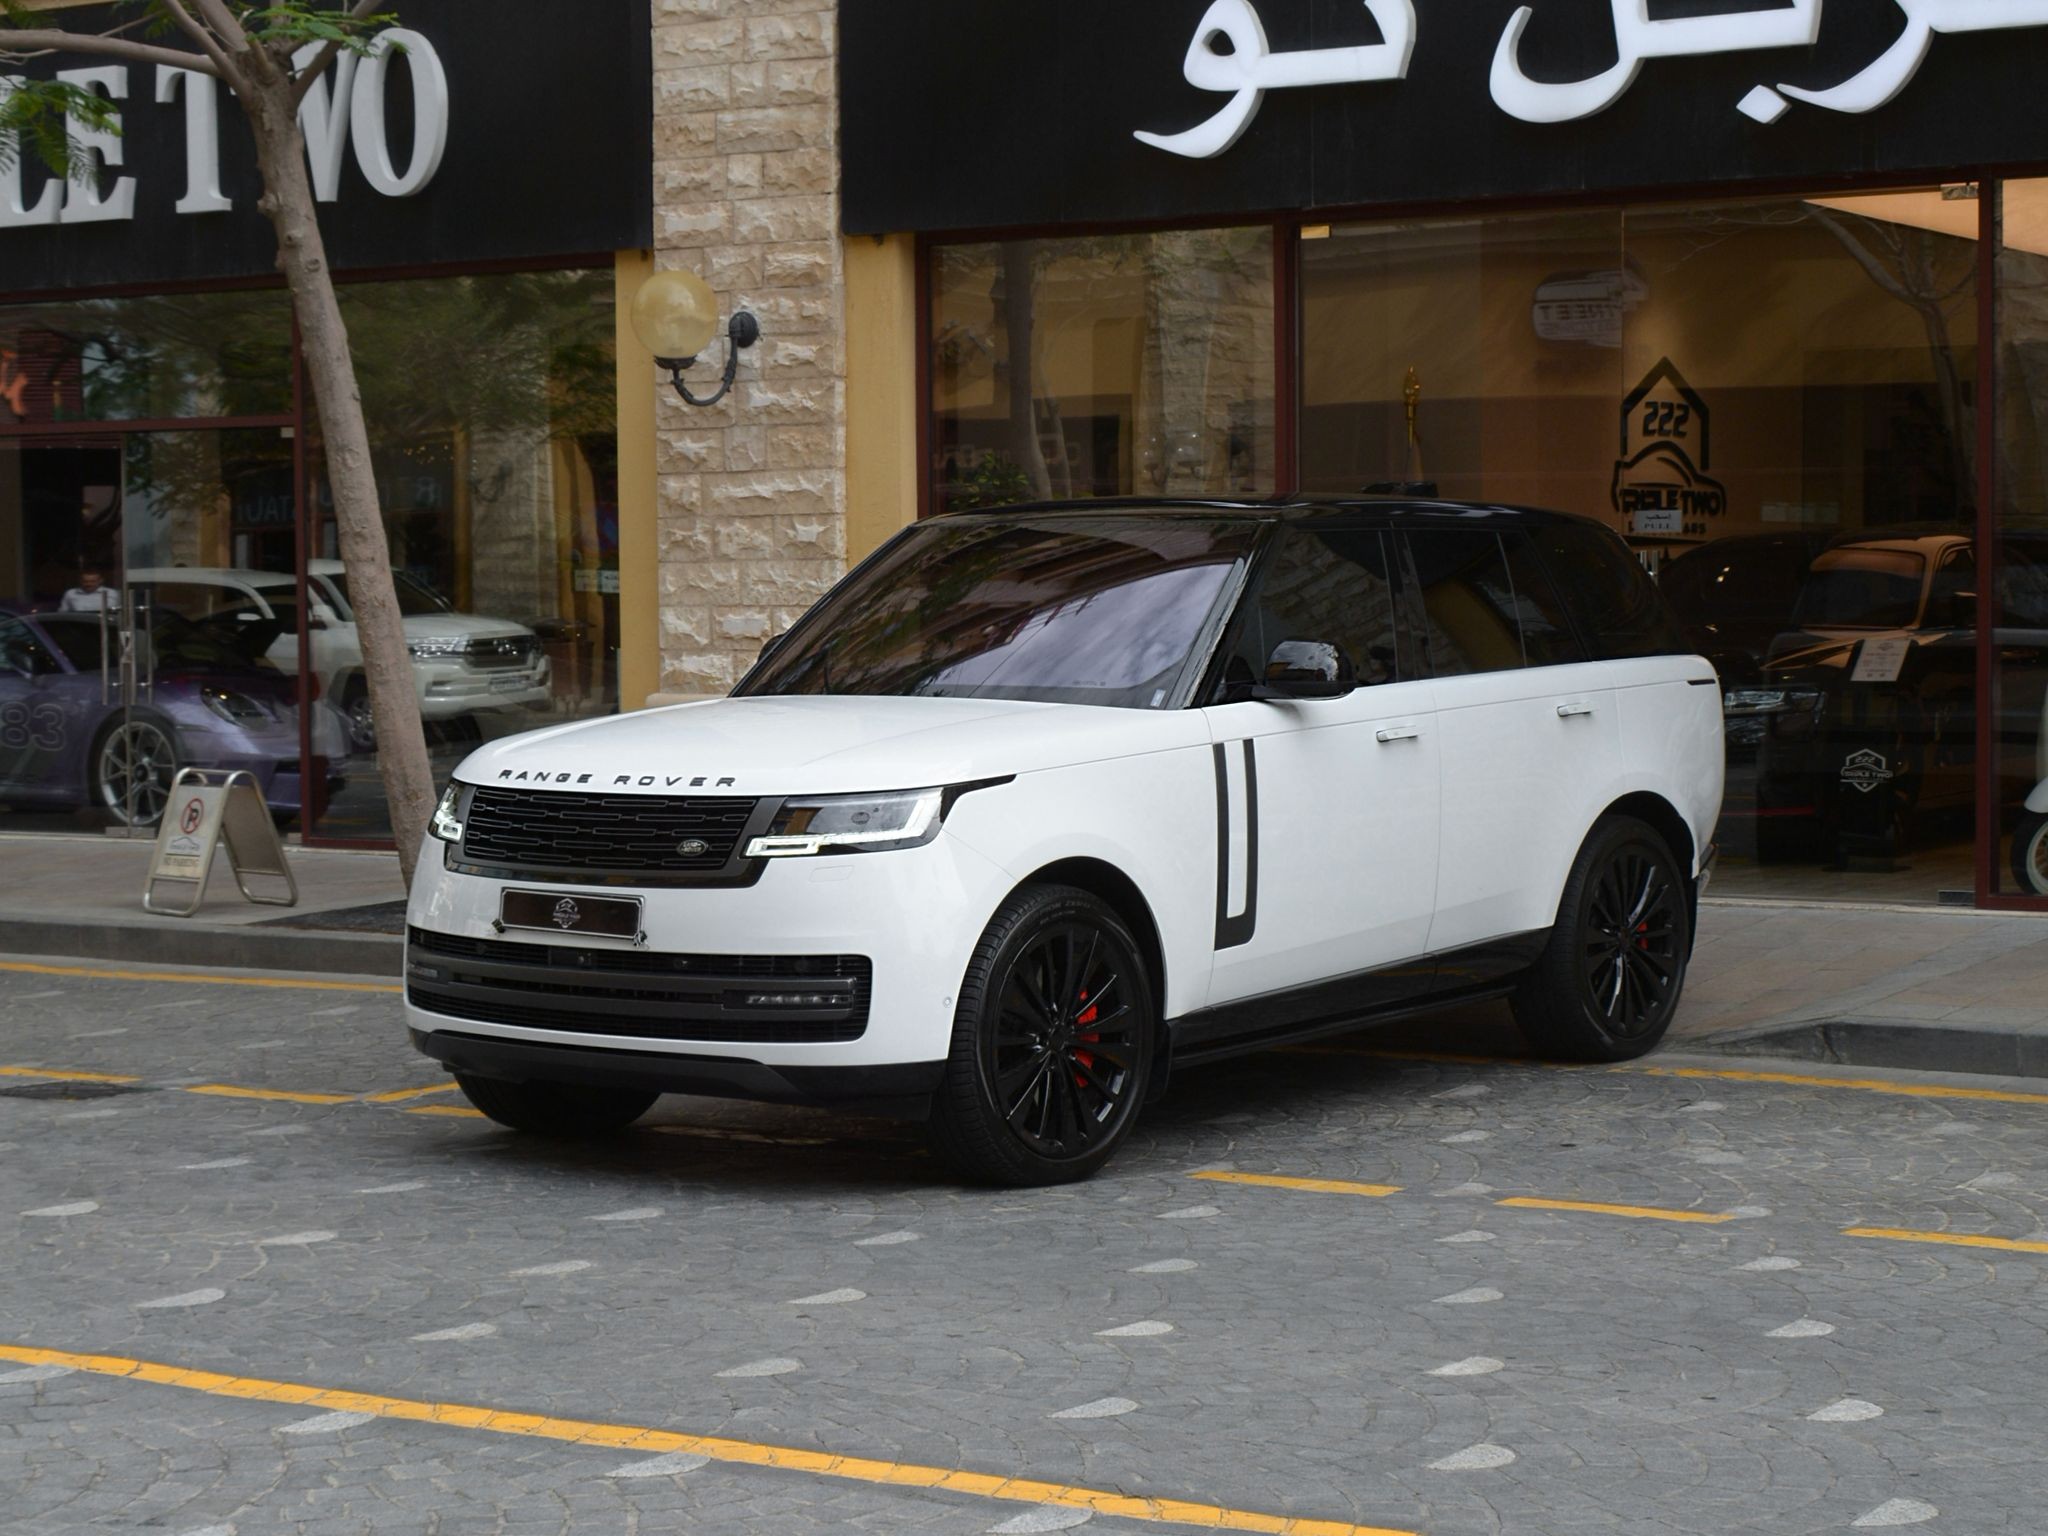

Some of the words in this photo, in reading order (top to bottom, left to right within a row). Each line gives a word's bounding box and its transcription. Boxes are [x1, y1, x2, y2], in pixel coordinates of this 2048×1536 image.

[1642, 401, 1690, 438] 222
[0, 701, 65, 752] 83
[498, 769, 593, 784] RANGE
[613, 775, 736, 787] ROVER
